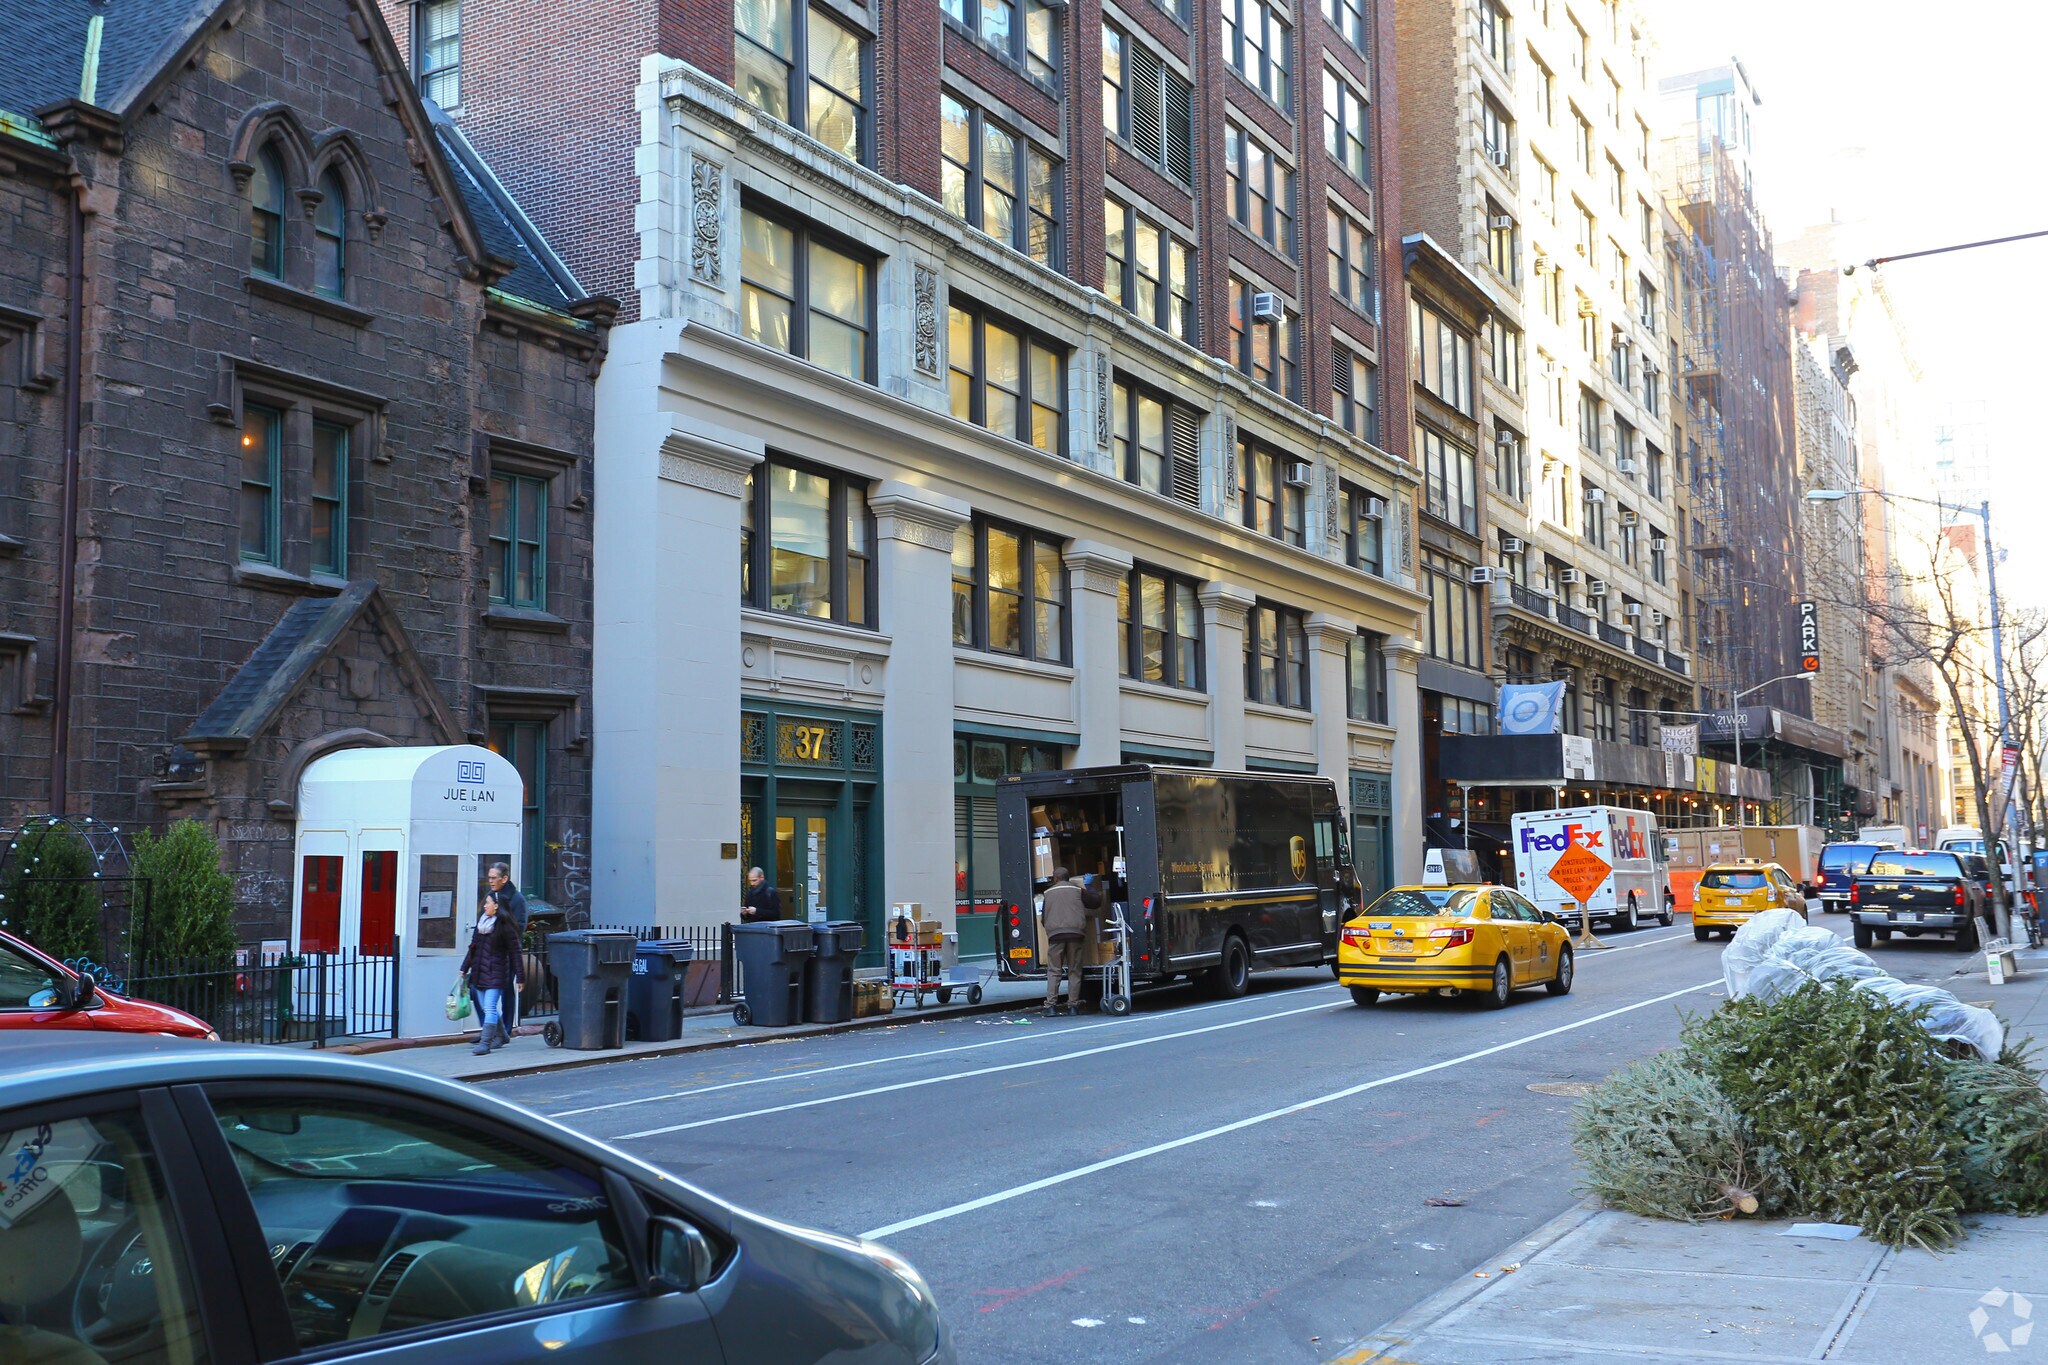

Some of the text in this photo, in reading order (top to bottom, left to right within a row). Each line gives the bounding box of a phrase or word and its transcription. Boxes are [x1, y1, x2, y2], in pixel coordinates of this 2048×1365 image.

[1801, 603, 1816, 650] PARK
[1665, 728, 1693, 737] HIGH
[796, 726, 824, 759] 37
[1663, 736, 1695, 746] STYLE
[1666, 746, 1692, 754] DECO
[443, 788, 495, 802] JUE LAN
[1520, 823, 1604, 853] FedEx
[1611, 814, 1646, 859] FedEx
[1171, 861, 1197, 873] Worldwide
[1292, 849, 1305, 875] ups
[1560, 858, 1596, 866] CONSTRUCTION
[1575, 866, 1587, 874] LANE
[639, 959, 648, 972] GAL
